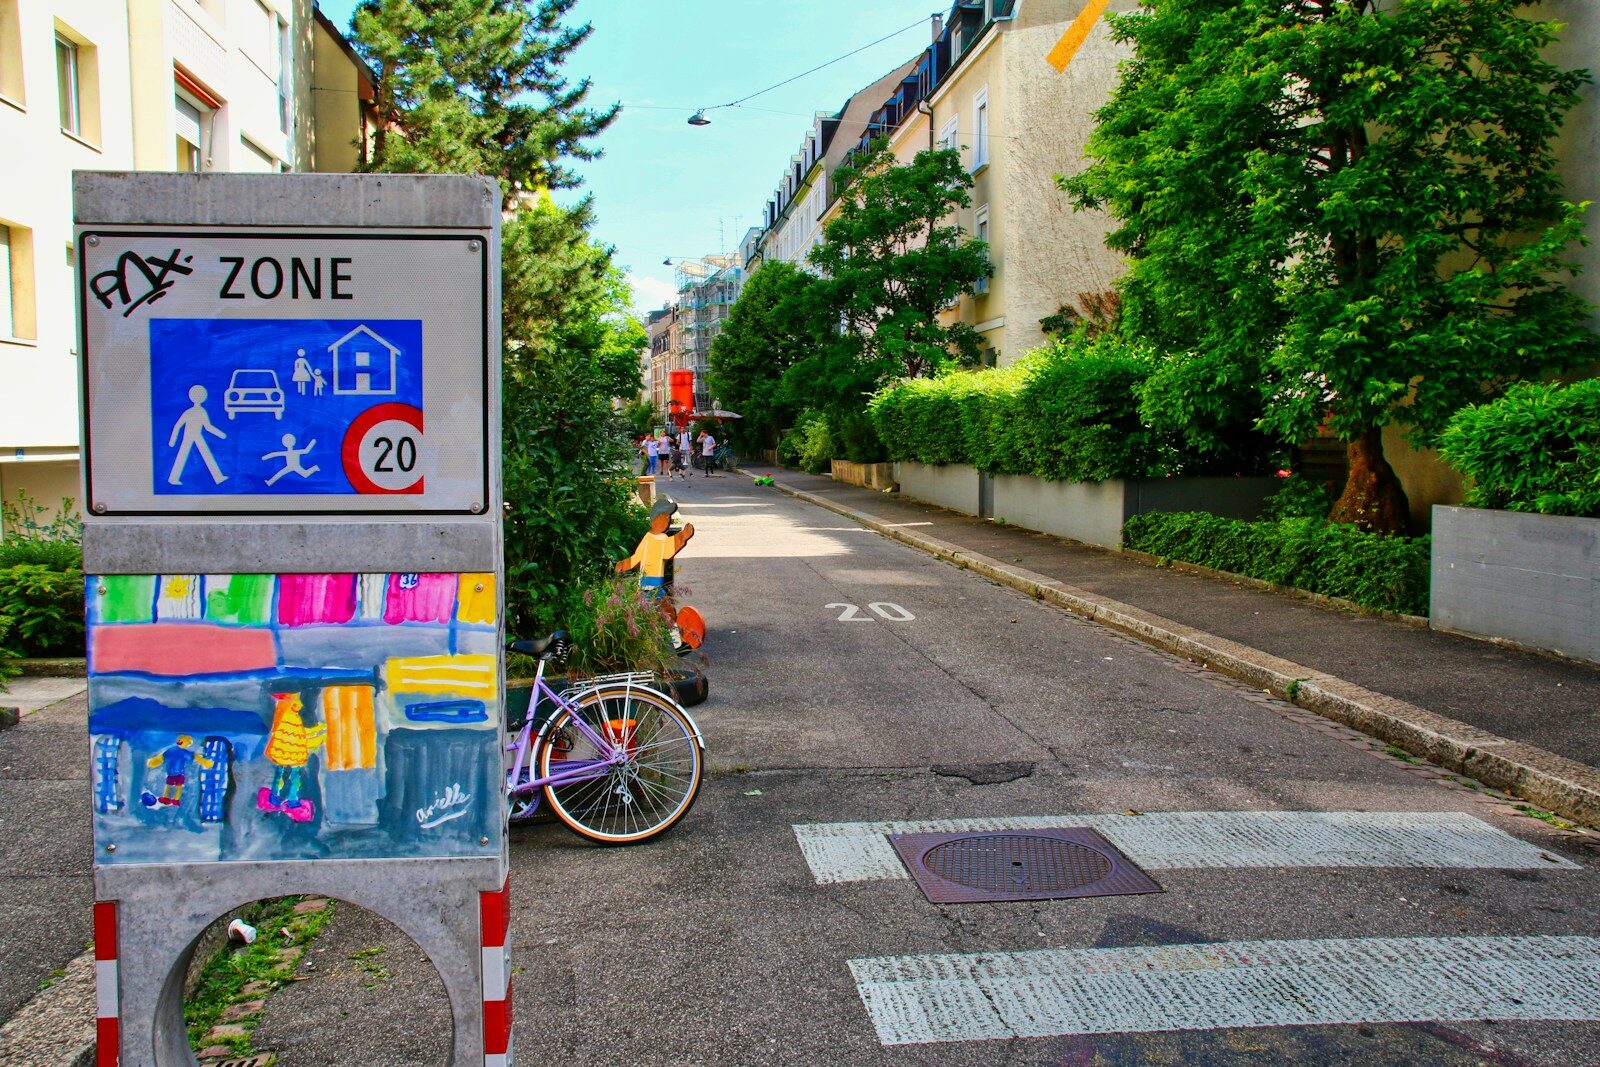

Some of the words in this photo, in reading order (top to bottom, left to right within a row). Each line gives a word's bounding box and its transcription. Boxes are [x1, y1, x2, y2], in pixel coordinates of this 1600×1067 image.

[219, 256, 354, 300] ZONE
[373, 436, 417, 472] 20
[824, 602, 916, 622] 20
